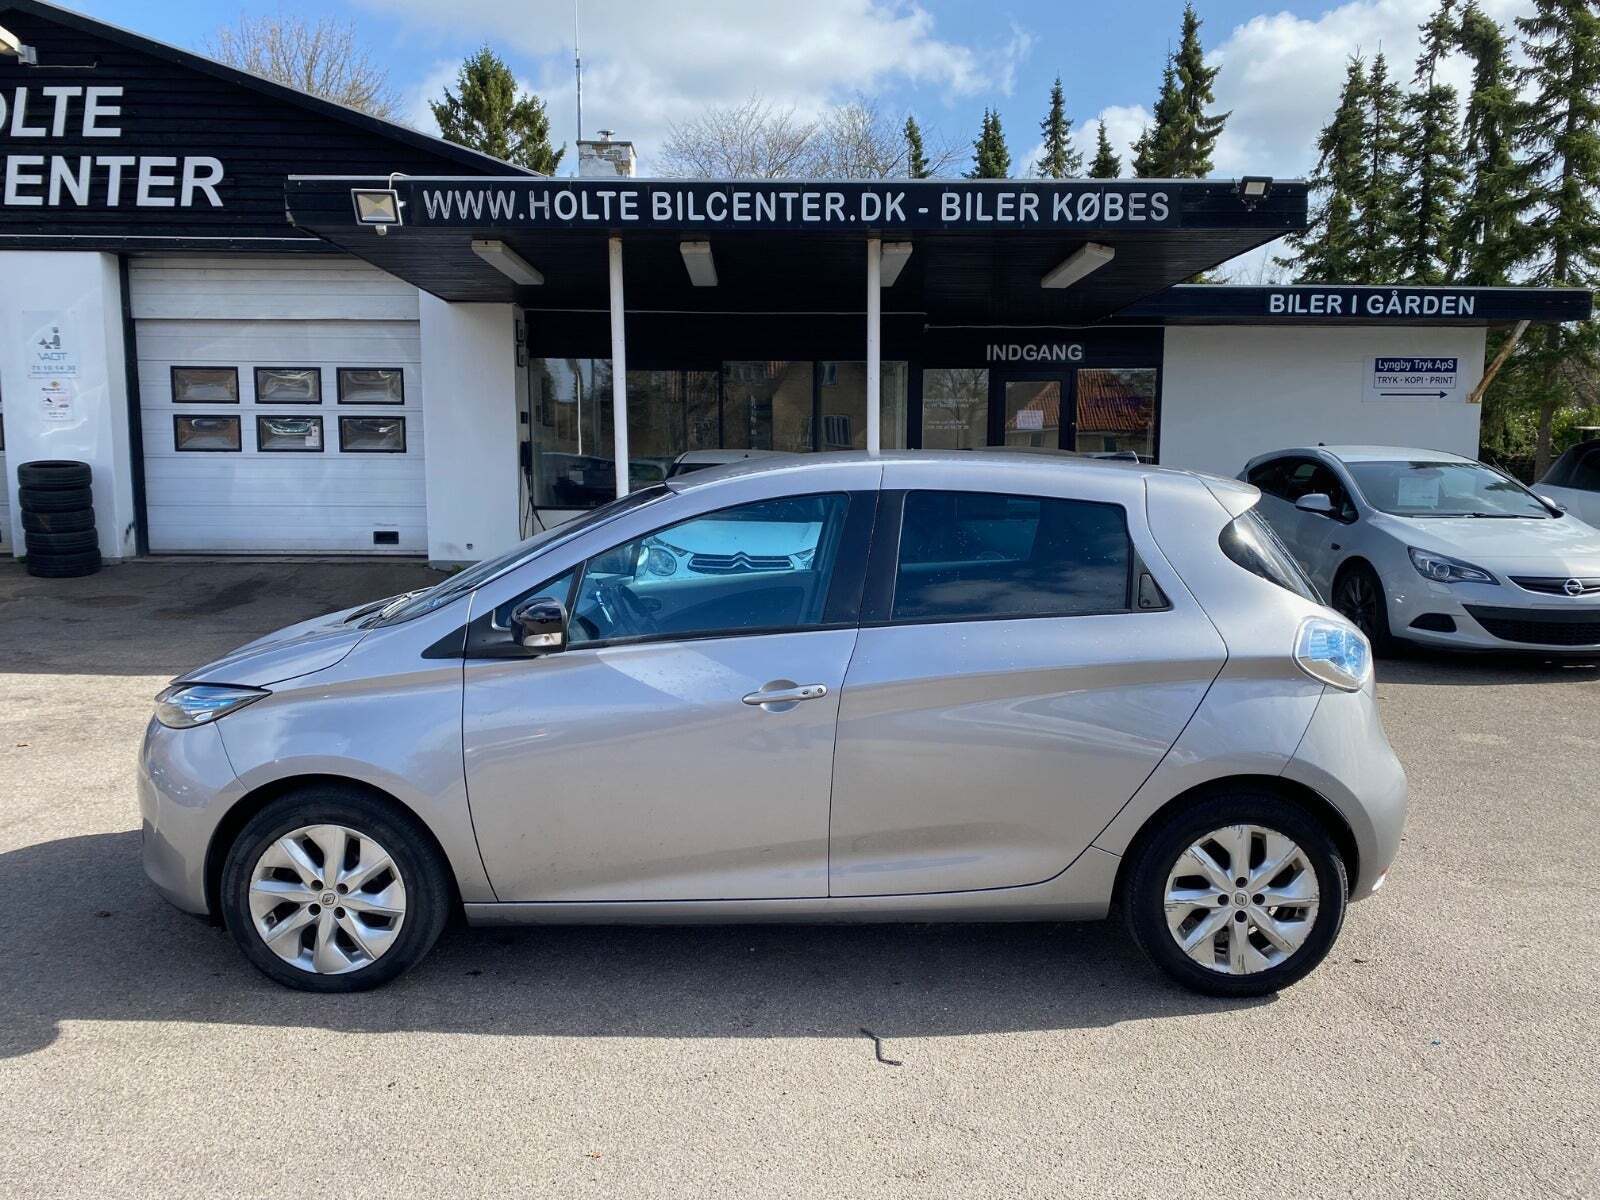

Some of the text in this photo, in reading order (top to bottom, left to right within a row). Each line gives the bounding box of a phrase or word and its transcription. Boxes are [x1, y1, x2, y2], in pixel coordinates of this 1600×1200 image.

[0, 86, 124, 137] LTE
[422, 190, 640, 222] WWW.HOLTE
[651, 191, 907, 222] BILCENTER.DK
[941, 191, 1040, 222] BILER
[1051, 191, 1170, 224] KØBES
[1269, 294, 1343, 315] BILER
[1366, 289, 1476, 315] GÅRDEN
[986, 344, 1083, 361] INDGANG
[1378, 359, 1454, 371] Lyngby Tryk ApS
[1377, 376, 1398, 384] TRYK
[1405, 376, 1424, 384] KOPI
[1429, 376, 1453, 384] PRINT
